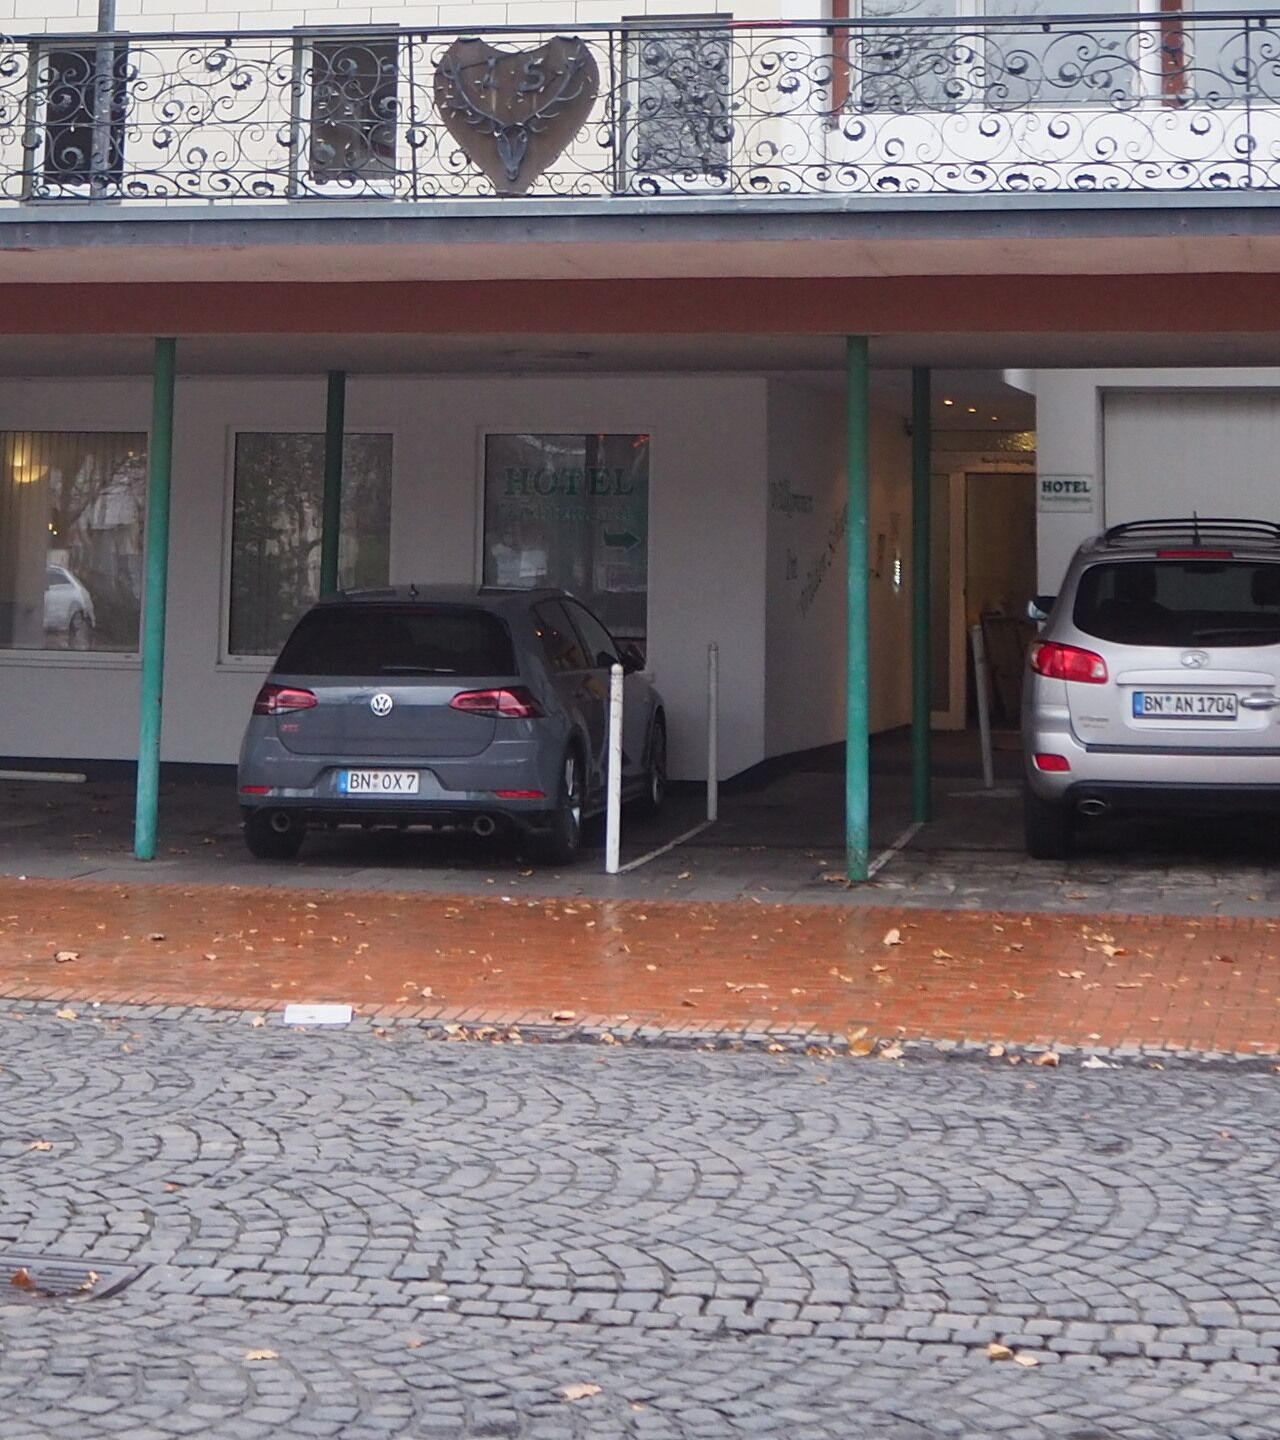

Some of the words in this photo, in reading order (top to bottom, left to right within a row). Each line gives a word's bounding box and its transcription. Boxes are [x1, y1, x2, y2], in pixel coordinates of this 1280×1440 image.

[504, 467, 634, 496] HOTEL
[1042, 480, 1091, 493] HOTEL
[1144, 696, 1163, 712] BN
[1175, 696, 1193, 713] AN
[1198, 697, 1235, 714] 1704
[350, 773, 370, 789] BN
[407, 774, 416, 790] 7
